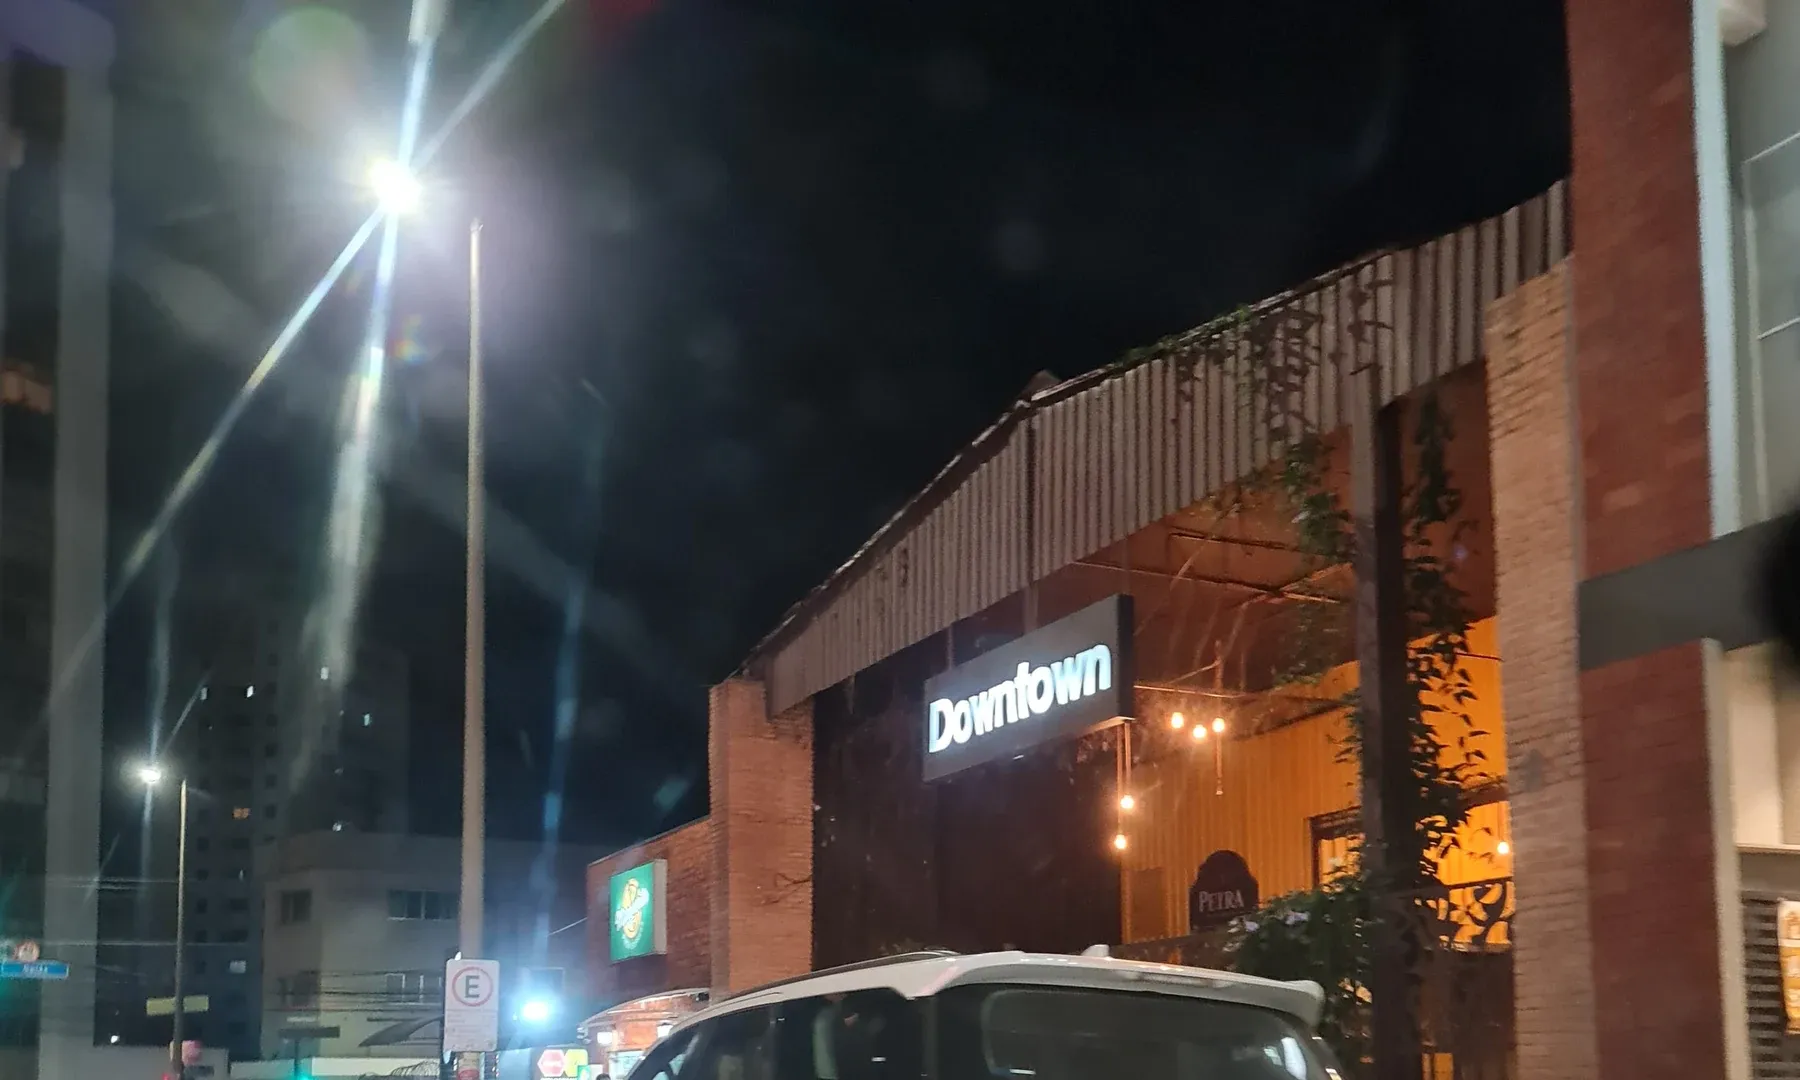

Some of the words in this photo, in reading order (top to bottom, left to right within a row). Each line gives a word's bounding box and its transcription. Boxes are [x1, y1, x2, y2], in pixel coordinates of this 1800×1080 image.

[928, 644, 1112, 753] Downtown
[1198, 889, 1245, 913] PETRA
[464, 974, 481, 999] E
